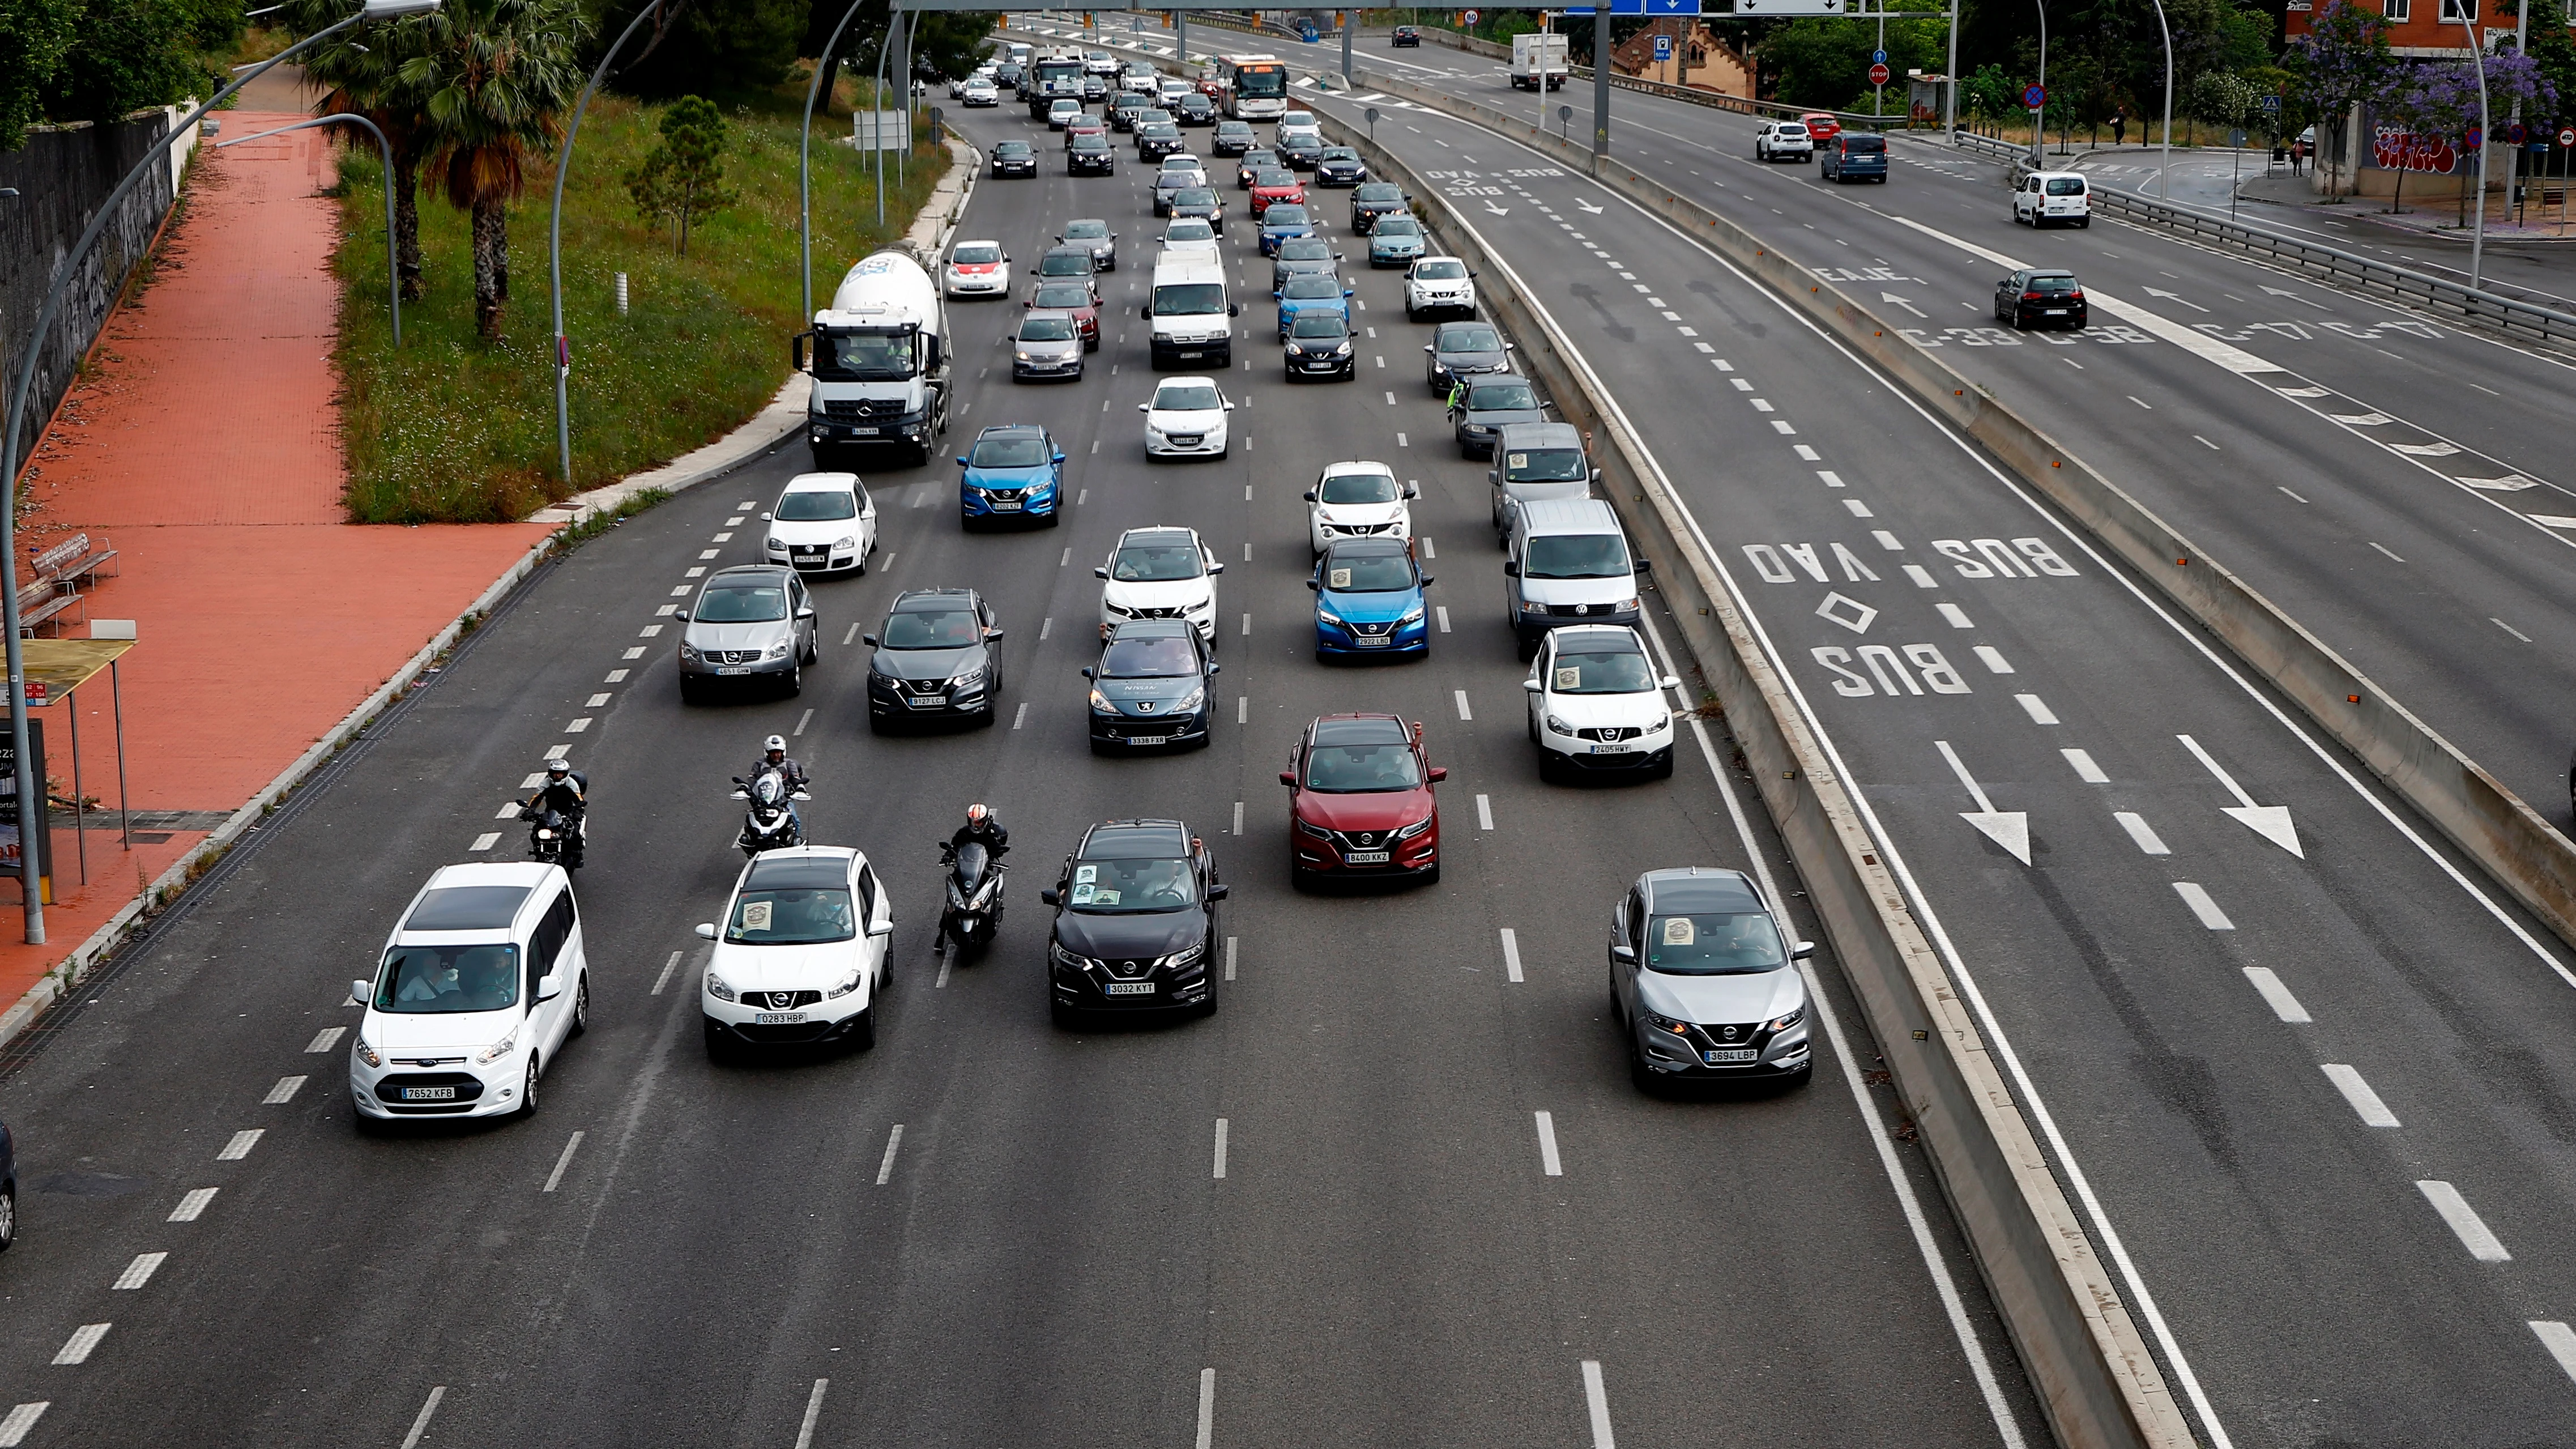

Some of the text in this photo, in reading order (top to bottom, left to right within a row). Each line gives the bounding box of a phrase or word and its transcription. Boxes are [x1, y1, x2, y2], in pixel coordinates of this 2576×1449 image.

[1425, 170, 1481, 179] VAO
[1507, 168, 1565, 178] BUS
[1444, 186, 1504, 197] BUS
[1811, 267, 1909, 281] EAJE
[1931, 537, 2081, 578] BUS
[1742, 543, 1880, 583] VAO
[1810, 643, 1973, 697] BUS
[1136, 984, 1152, 992] KYT
[762, 1014, 803, 1023] 0283 HBP
[1712, 1051, 1755, 1060] 3694 LBP
[408, 1089, 453, 1098] 7652 KFB
